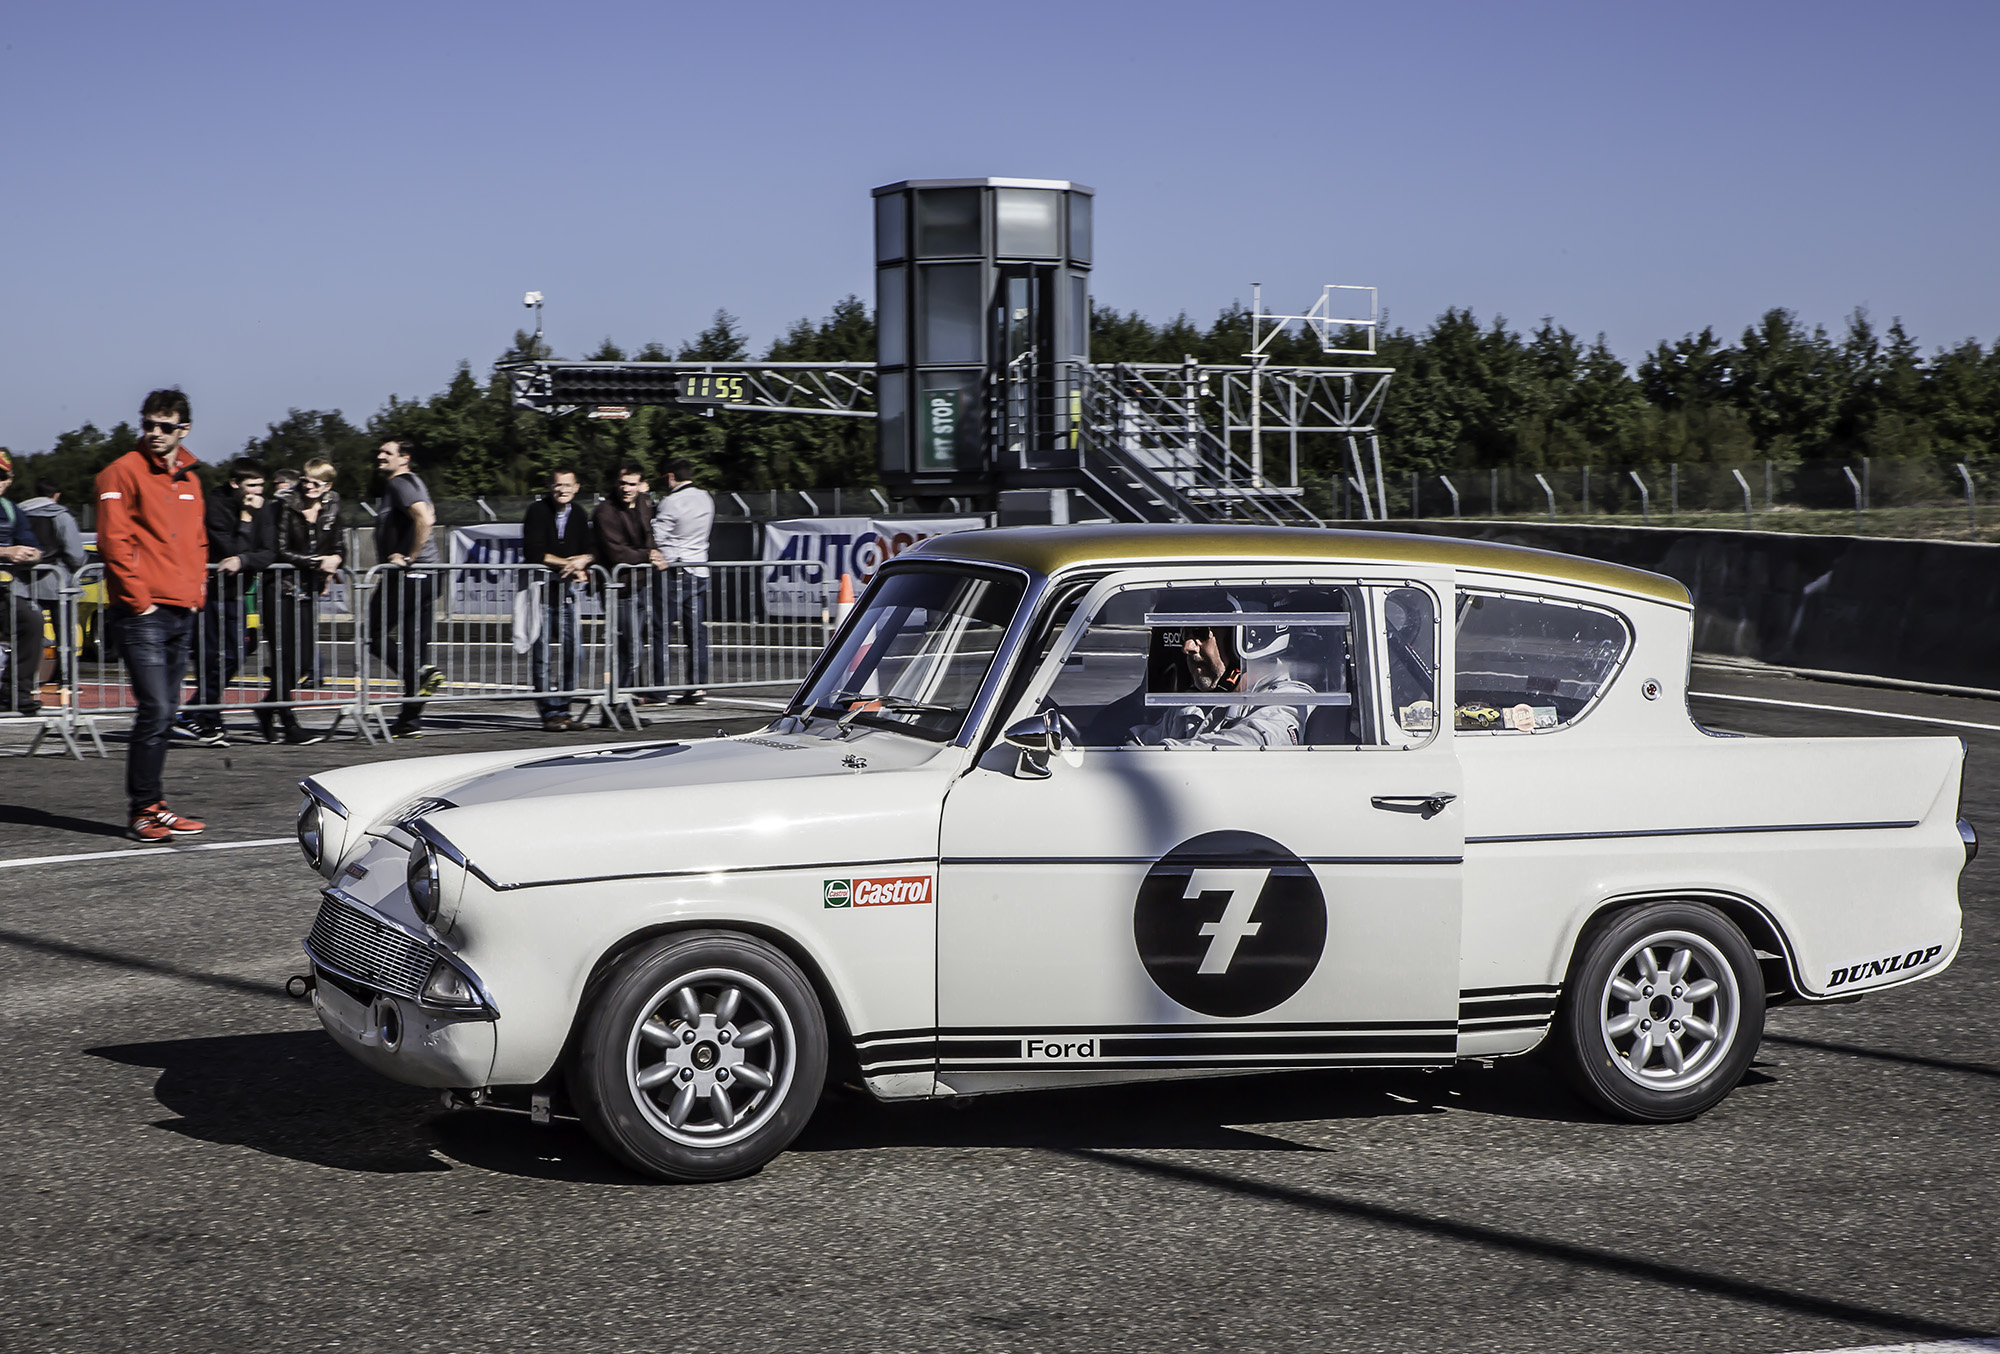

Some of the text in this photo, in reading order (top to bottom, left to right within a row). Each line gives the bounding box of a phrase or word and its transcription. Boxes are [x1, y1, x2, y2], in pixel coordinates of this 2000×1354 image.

[931, 398, 954, 460] PIT STOP
[829, 890, 848, 898] Castrol
[854, 878, 930, 905] Castrol
[1182, 868, 1272, 975] 7
[1825, 944, 1942, 989] DUNLOP
[1027, 1038, 1094, 1059] Ford
